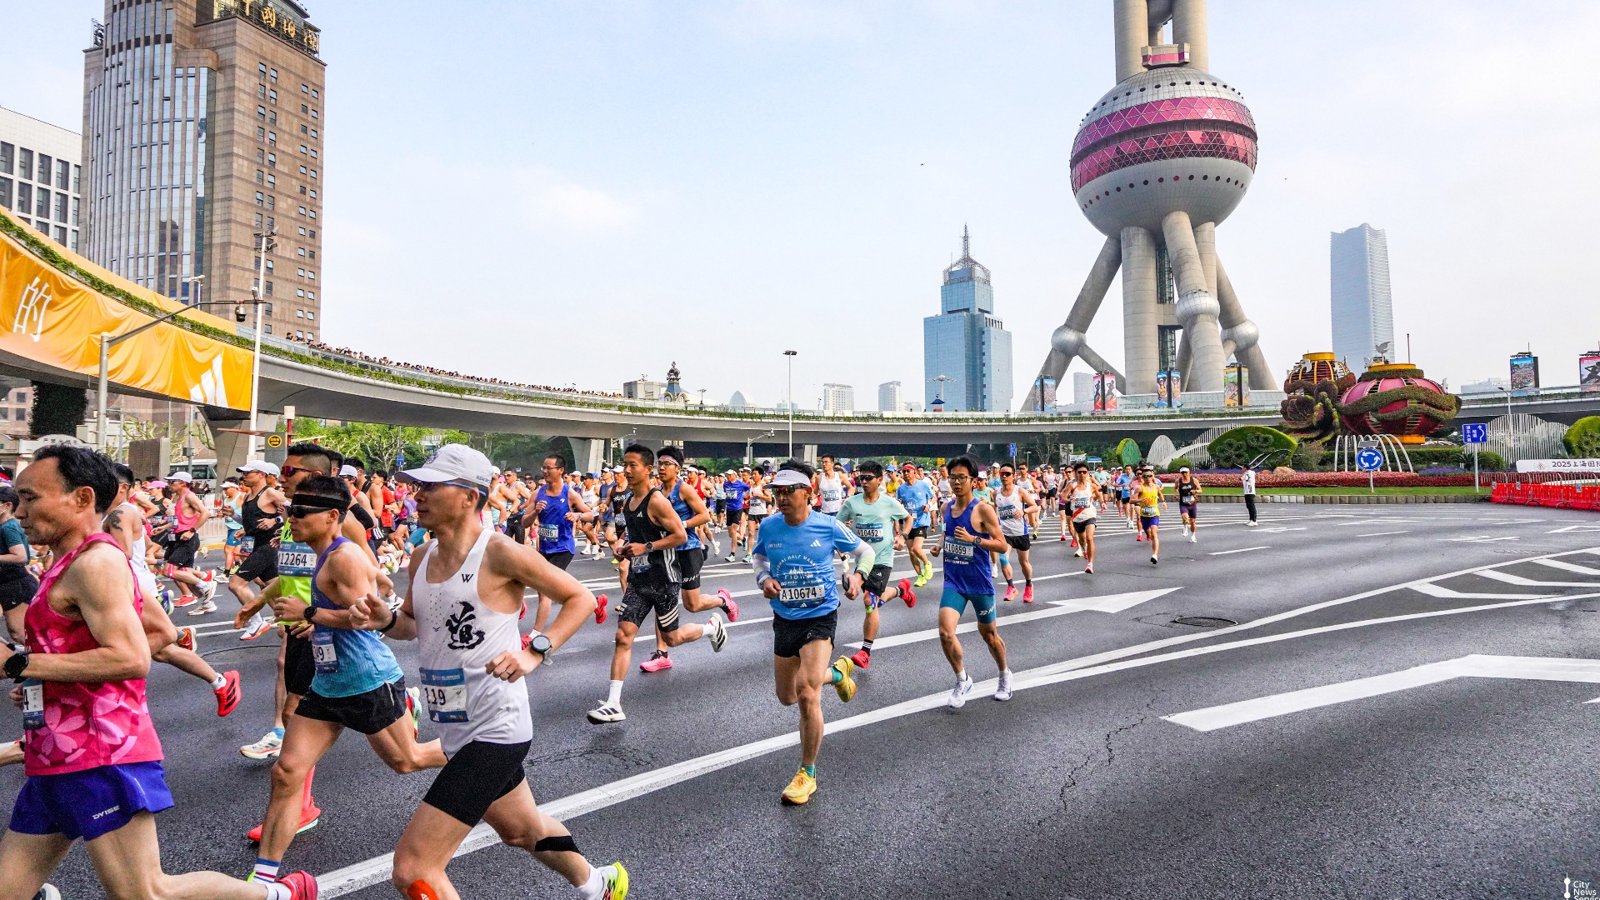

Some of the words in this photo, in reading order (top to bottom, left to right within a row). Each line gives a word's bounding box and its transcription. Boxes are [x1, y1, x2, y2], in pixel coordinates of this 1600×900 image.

[13, 276, 52, 342] 的
[461, 573, 474, 583] W
[781, 587, 817, 600] A10674
